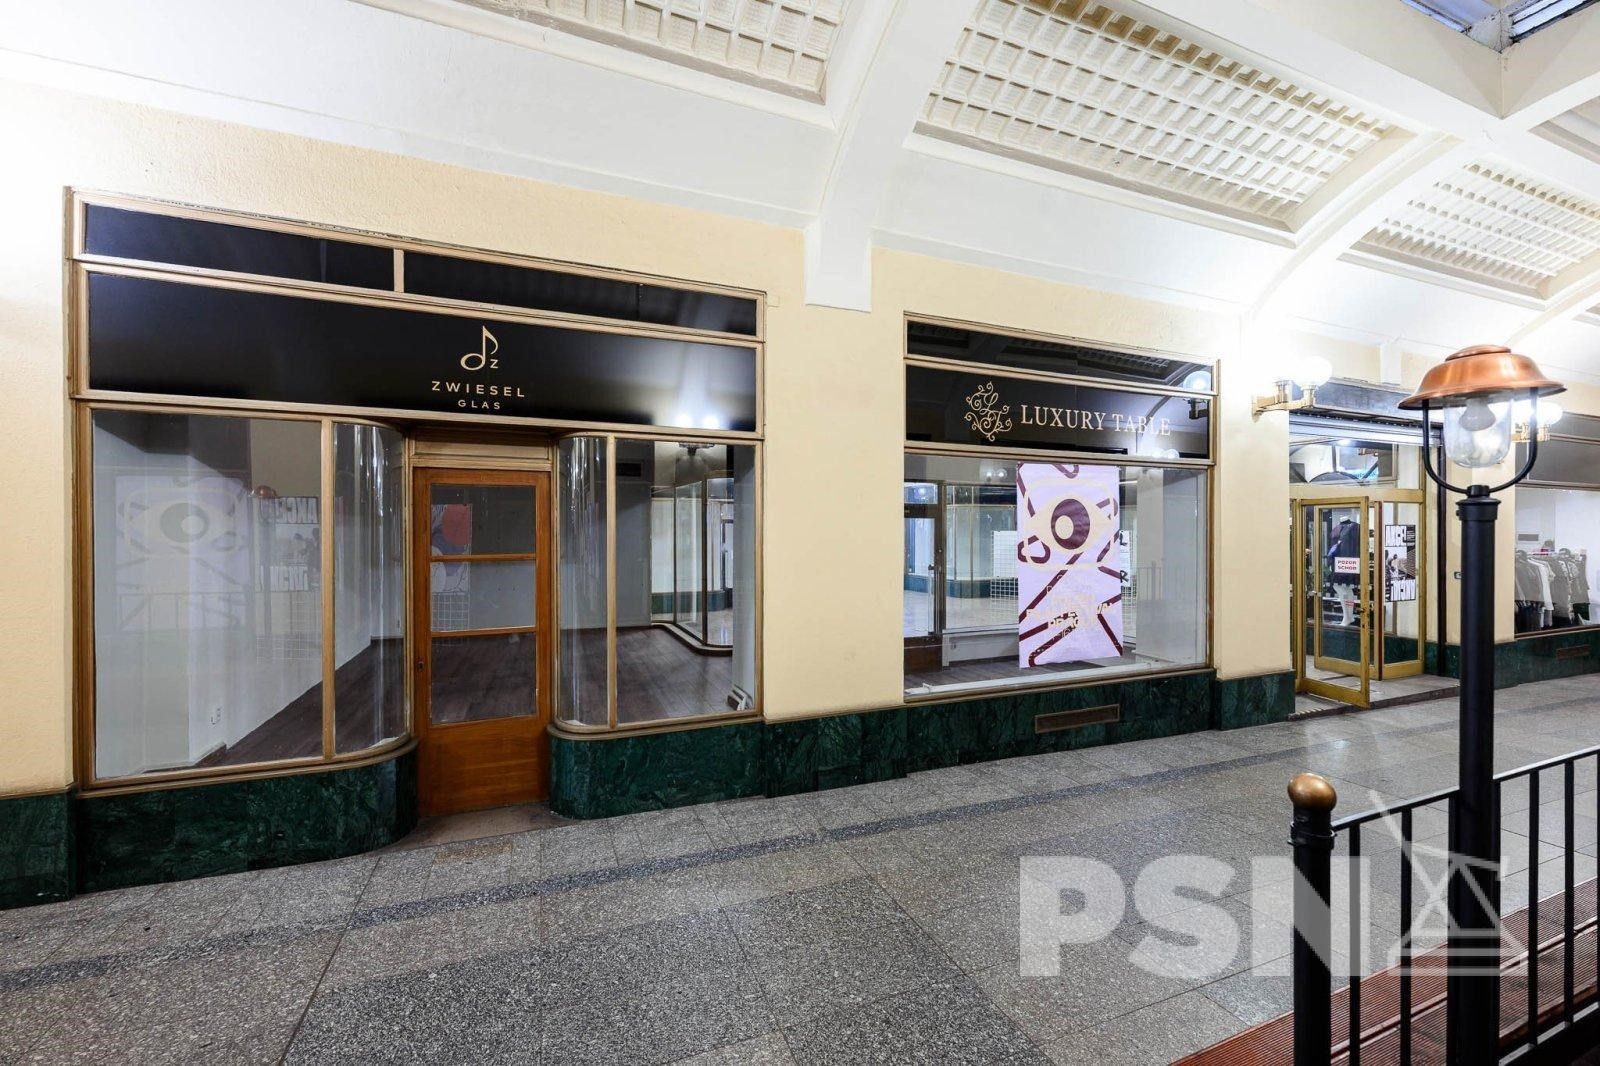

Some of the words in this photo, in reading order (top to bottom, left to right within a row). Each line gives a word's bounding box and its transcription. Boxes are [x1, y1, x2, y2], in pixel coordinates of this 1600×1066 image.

[431, 380, 525, 398] ZWIESEL
[457, 399, 501, 410] GLAS
[1020, 404, 1106, 431] LUXURY
[1111, 413, 1172, 436] TABLE
